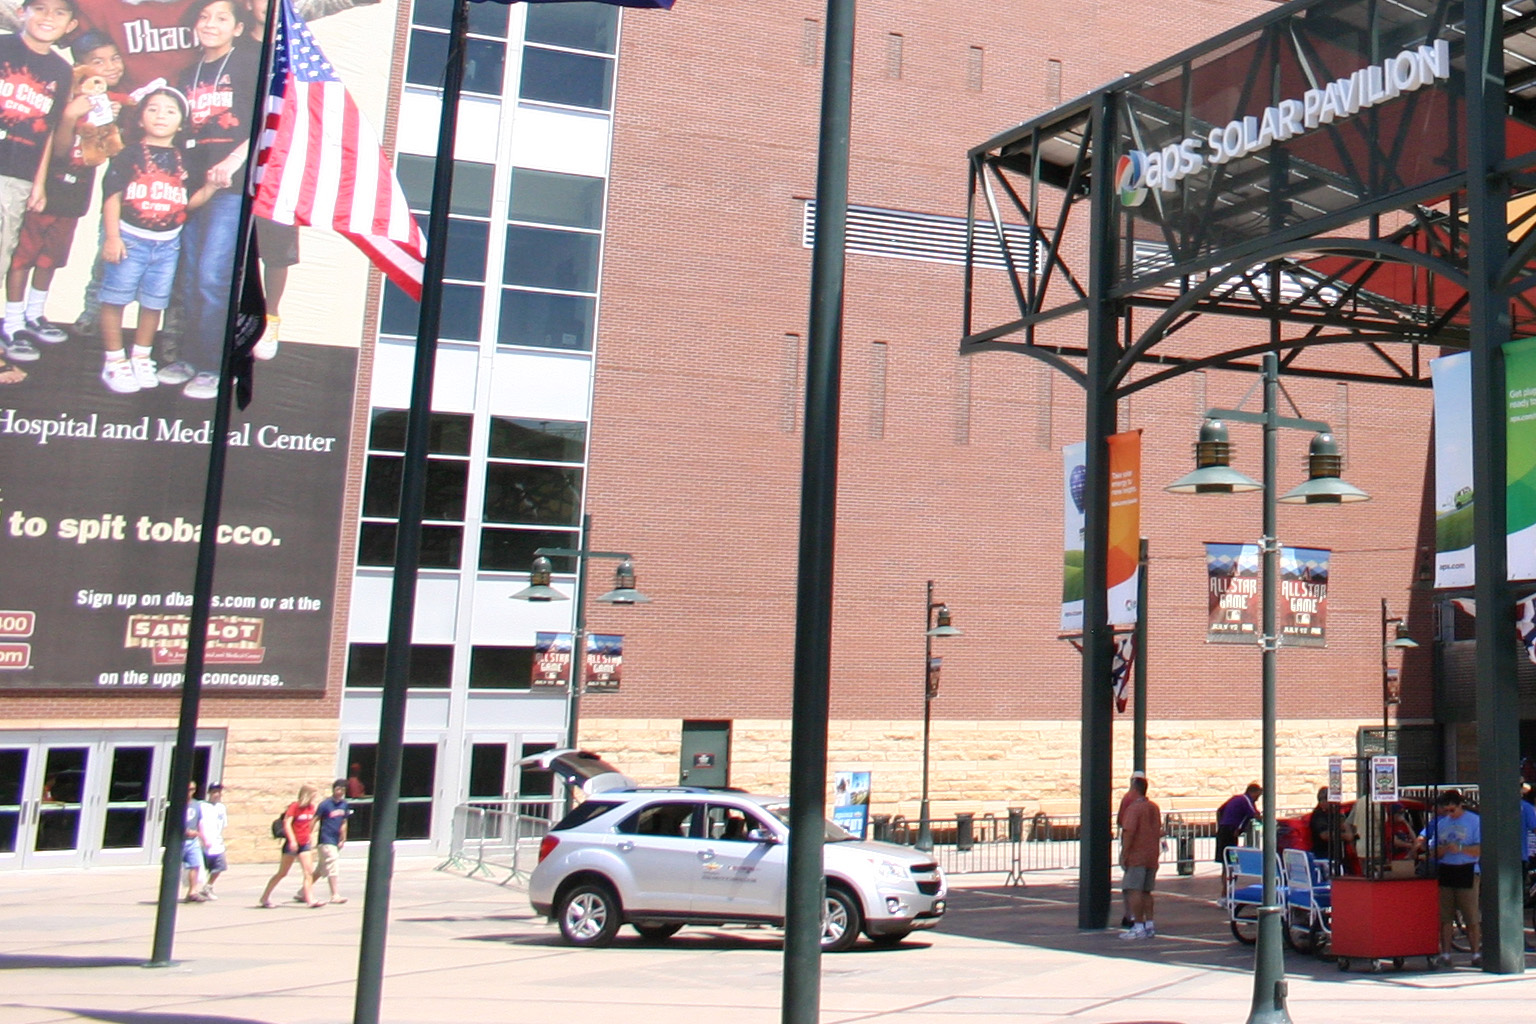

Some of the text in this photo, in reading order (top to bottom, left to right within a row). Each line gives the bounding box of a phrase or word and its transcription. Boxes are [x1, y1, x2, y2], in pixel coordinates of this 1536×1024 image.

[123, 19, 200, 54] Dbac
[1145, 38, 1450, 193] aps SOLAR PAVILION
[0, 409, 336, 453] Hospital and Medal Center
[9, 510, 281, 546] to spit tobacco.
[1439, 563, 1465, 571] aps.com
[76, 590, 321, 611] Sign up on dbas.com or at the
[1220, 594, 1249, 609] GAME
[1290, 597, 1318, 613] GAME
[135, 621, 256, 639] SANLOT
[98, 670, 284, 688] on the upp concourse.
